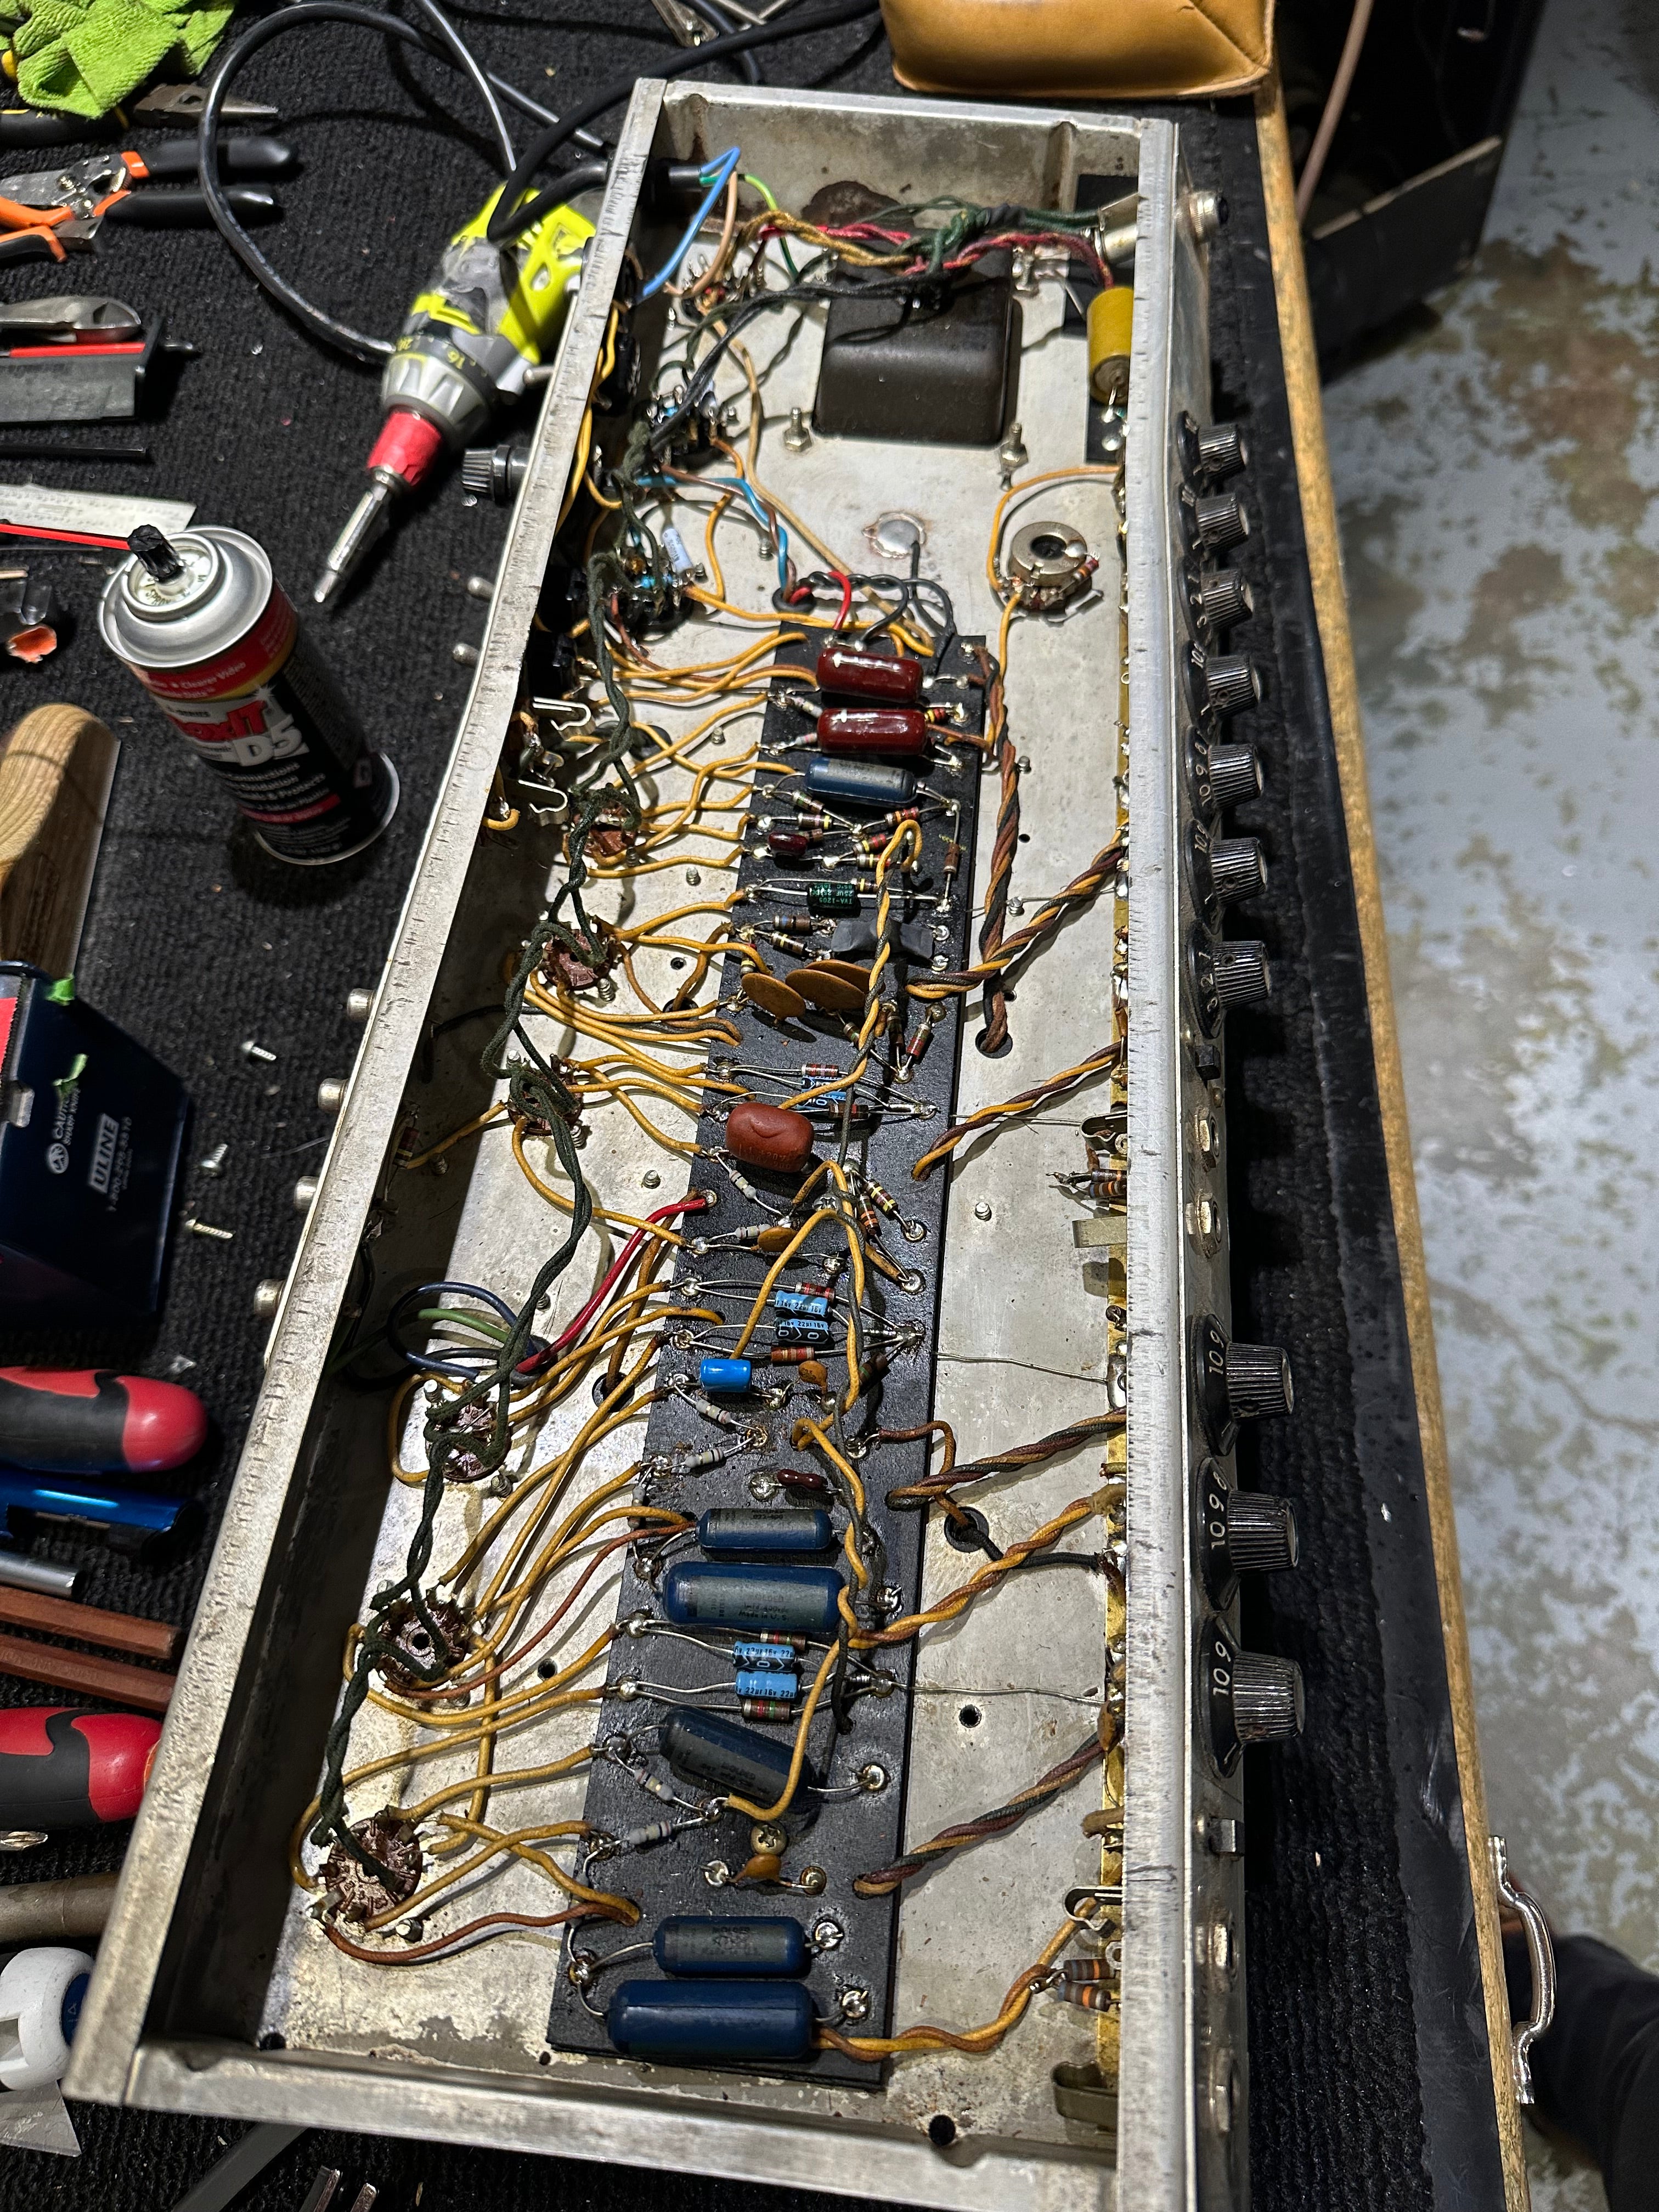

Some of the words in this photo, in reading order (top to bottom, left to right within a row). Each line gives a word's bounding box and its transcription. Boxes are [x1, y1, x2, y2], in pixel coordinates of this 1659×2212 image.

[1190, 594, 1202, 605] 2
[1191, 650, 1205, 669] 10
[233, 715, 307, 767] D5
[1195, 742, 1207, 755] 8
[1196, 764, 1207, 776] 9
[1199, 784, 1211, 807] 10
[1194, 834, 1207, 854] 10
[1201, 973, 1214, 989] 2
[94, 1119, 116, 1186] ULINE
[1210, 1330, 1224, 1348] 9
[1209, 1350, 1224, 1375] 10
[1213, 1471, 1227, 1491] 8
[1209, 1493, 1224, 1512] 9
[1210, 1521, 1226, 1550] 10
[1215, 1641, 1231, 1662] 9
[1213, 1668, 1230, 1696] 10
